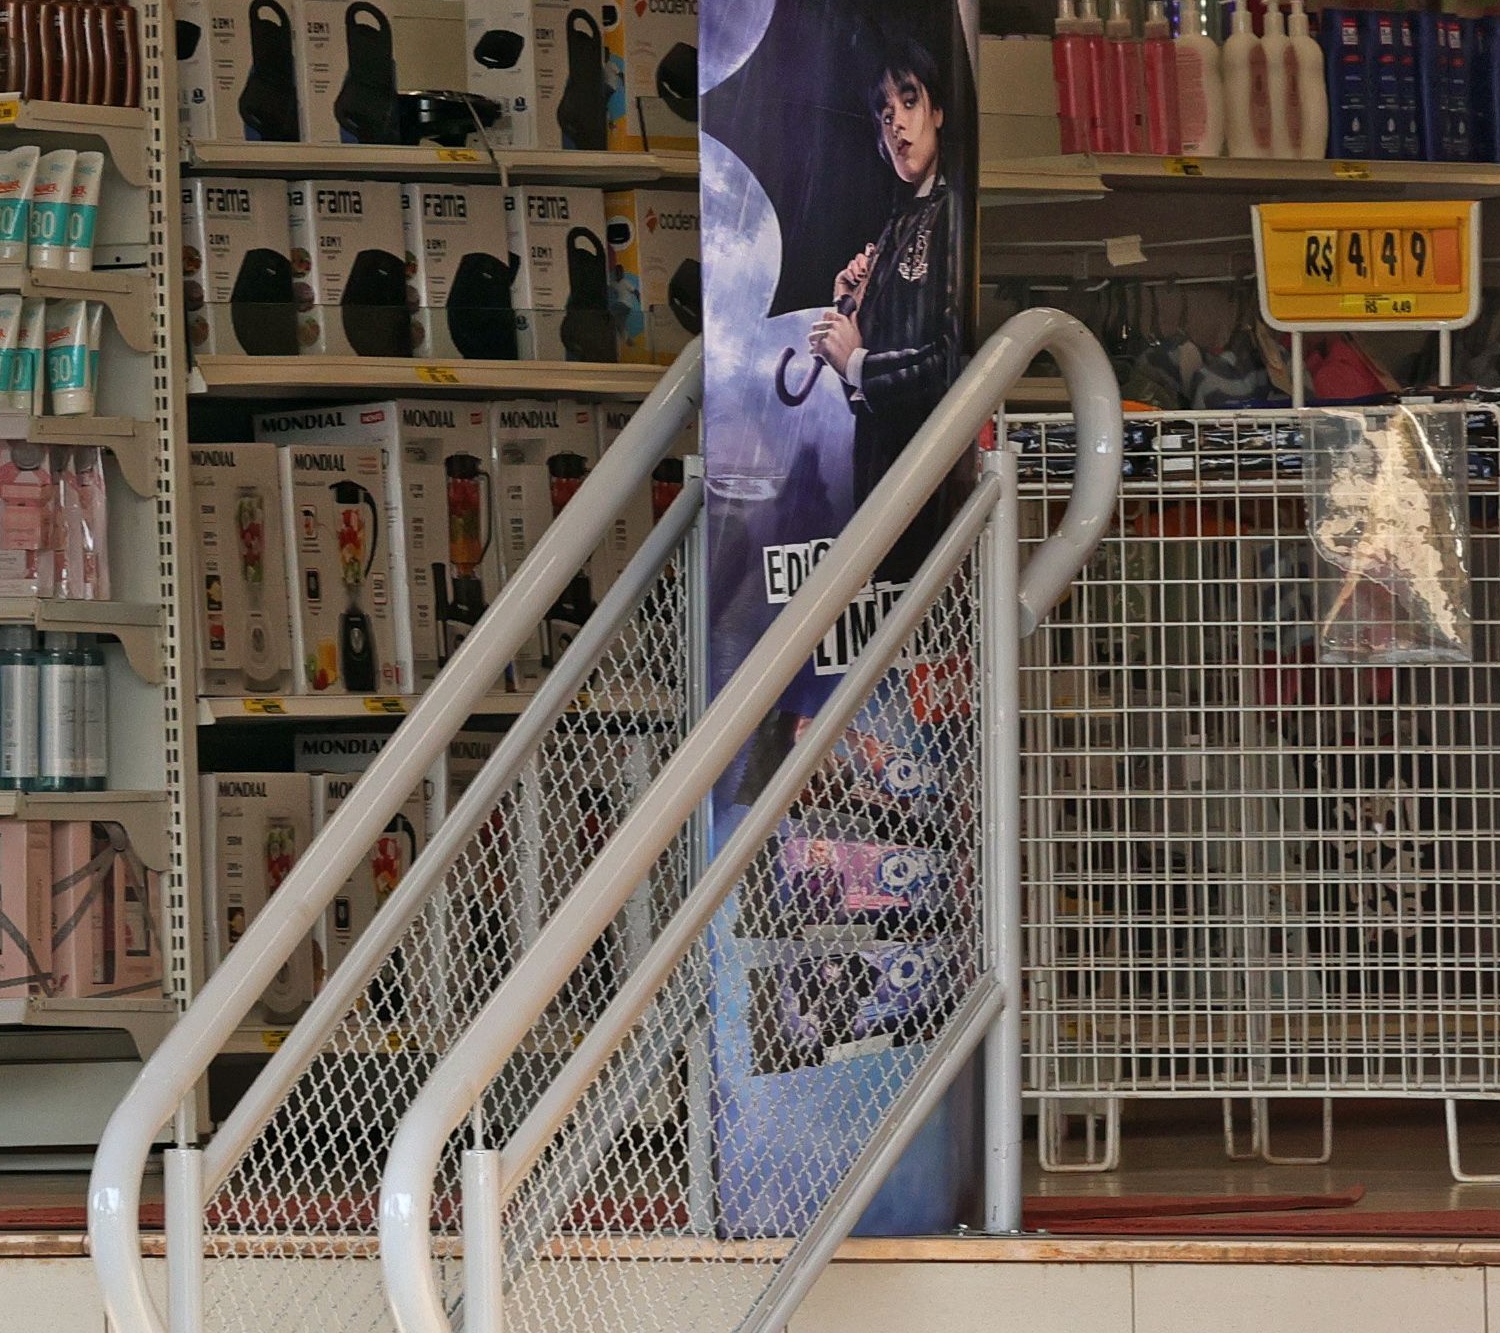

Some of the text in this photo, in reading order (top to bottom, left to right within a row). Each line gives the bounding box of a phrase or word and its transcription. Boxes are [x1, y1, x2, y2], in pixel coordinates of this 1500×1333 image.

[1306, 231, 1426, 282] R$ 4,49
[1365, 300, 1378, 314] R$
[261, 412, 346, 433] MONDIAL
[403, 410, 456, 428] MONDIAL
[500, 410, 559, 429] MONDIAL
[191, 451, 236, 467] MONDIAL
[294, 454, 346, 472] MONDIAL
[218, 782, 267, 798] MONDIAL
